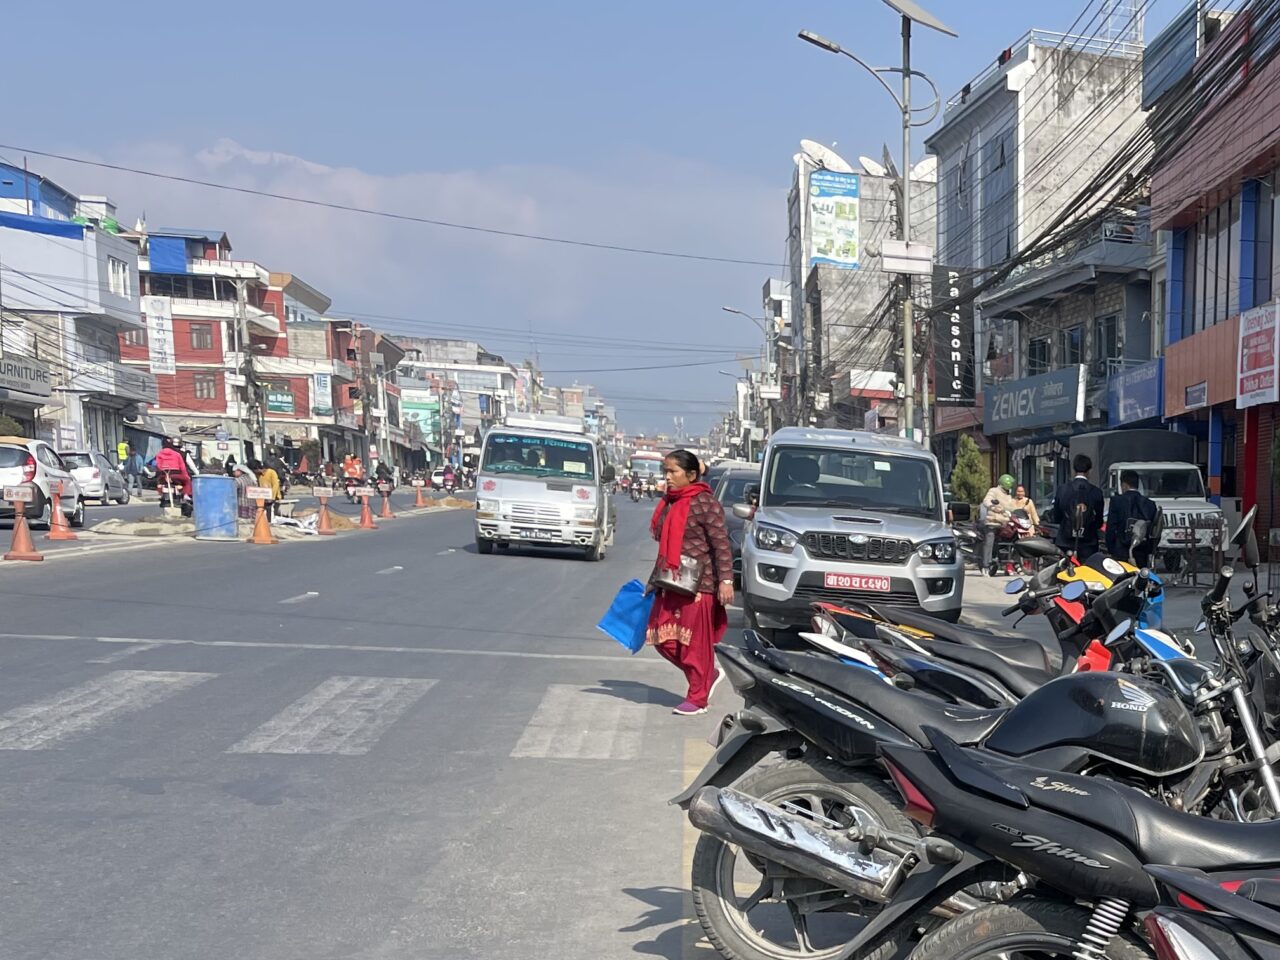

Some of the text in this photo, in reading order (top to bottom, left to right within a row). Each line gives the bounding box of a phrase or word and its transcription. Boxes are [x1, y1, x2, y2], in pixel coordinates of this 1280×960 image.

[948, 271, 962, 390] Paasonic
[992, 387, 1036, 421] ZENEX
[1010, 834, 1110, 869] Shine
